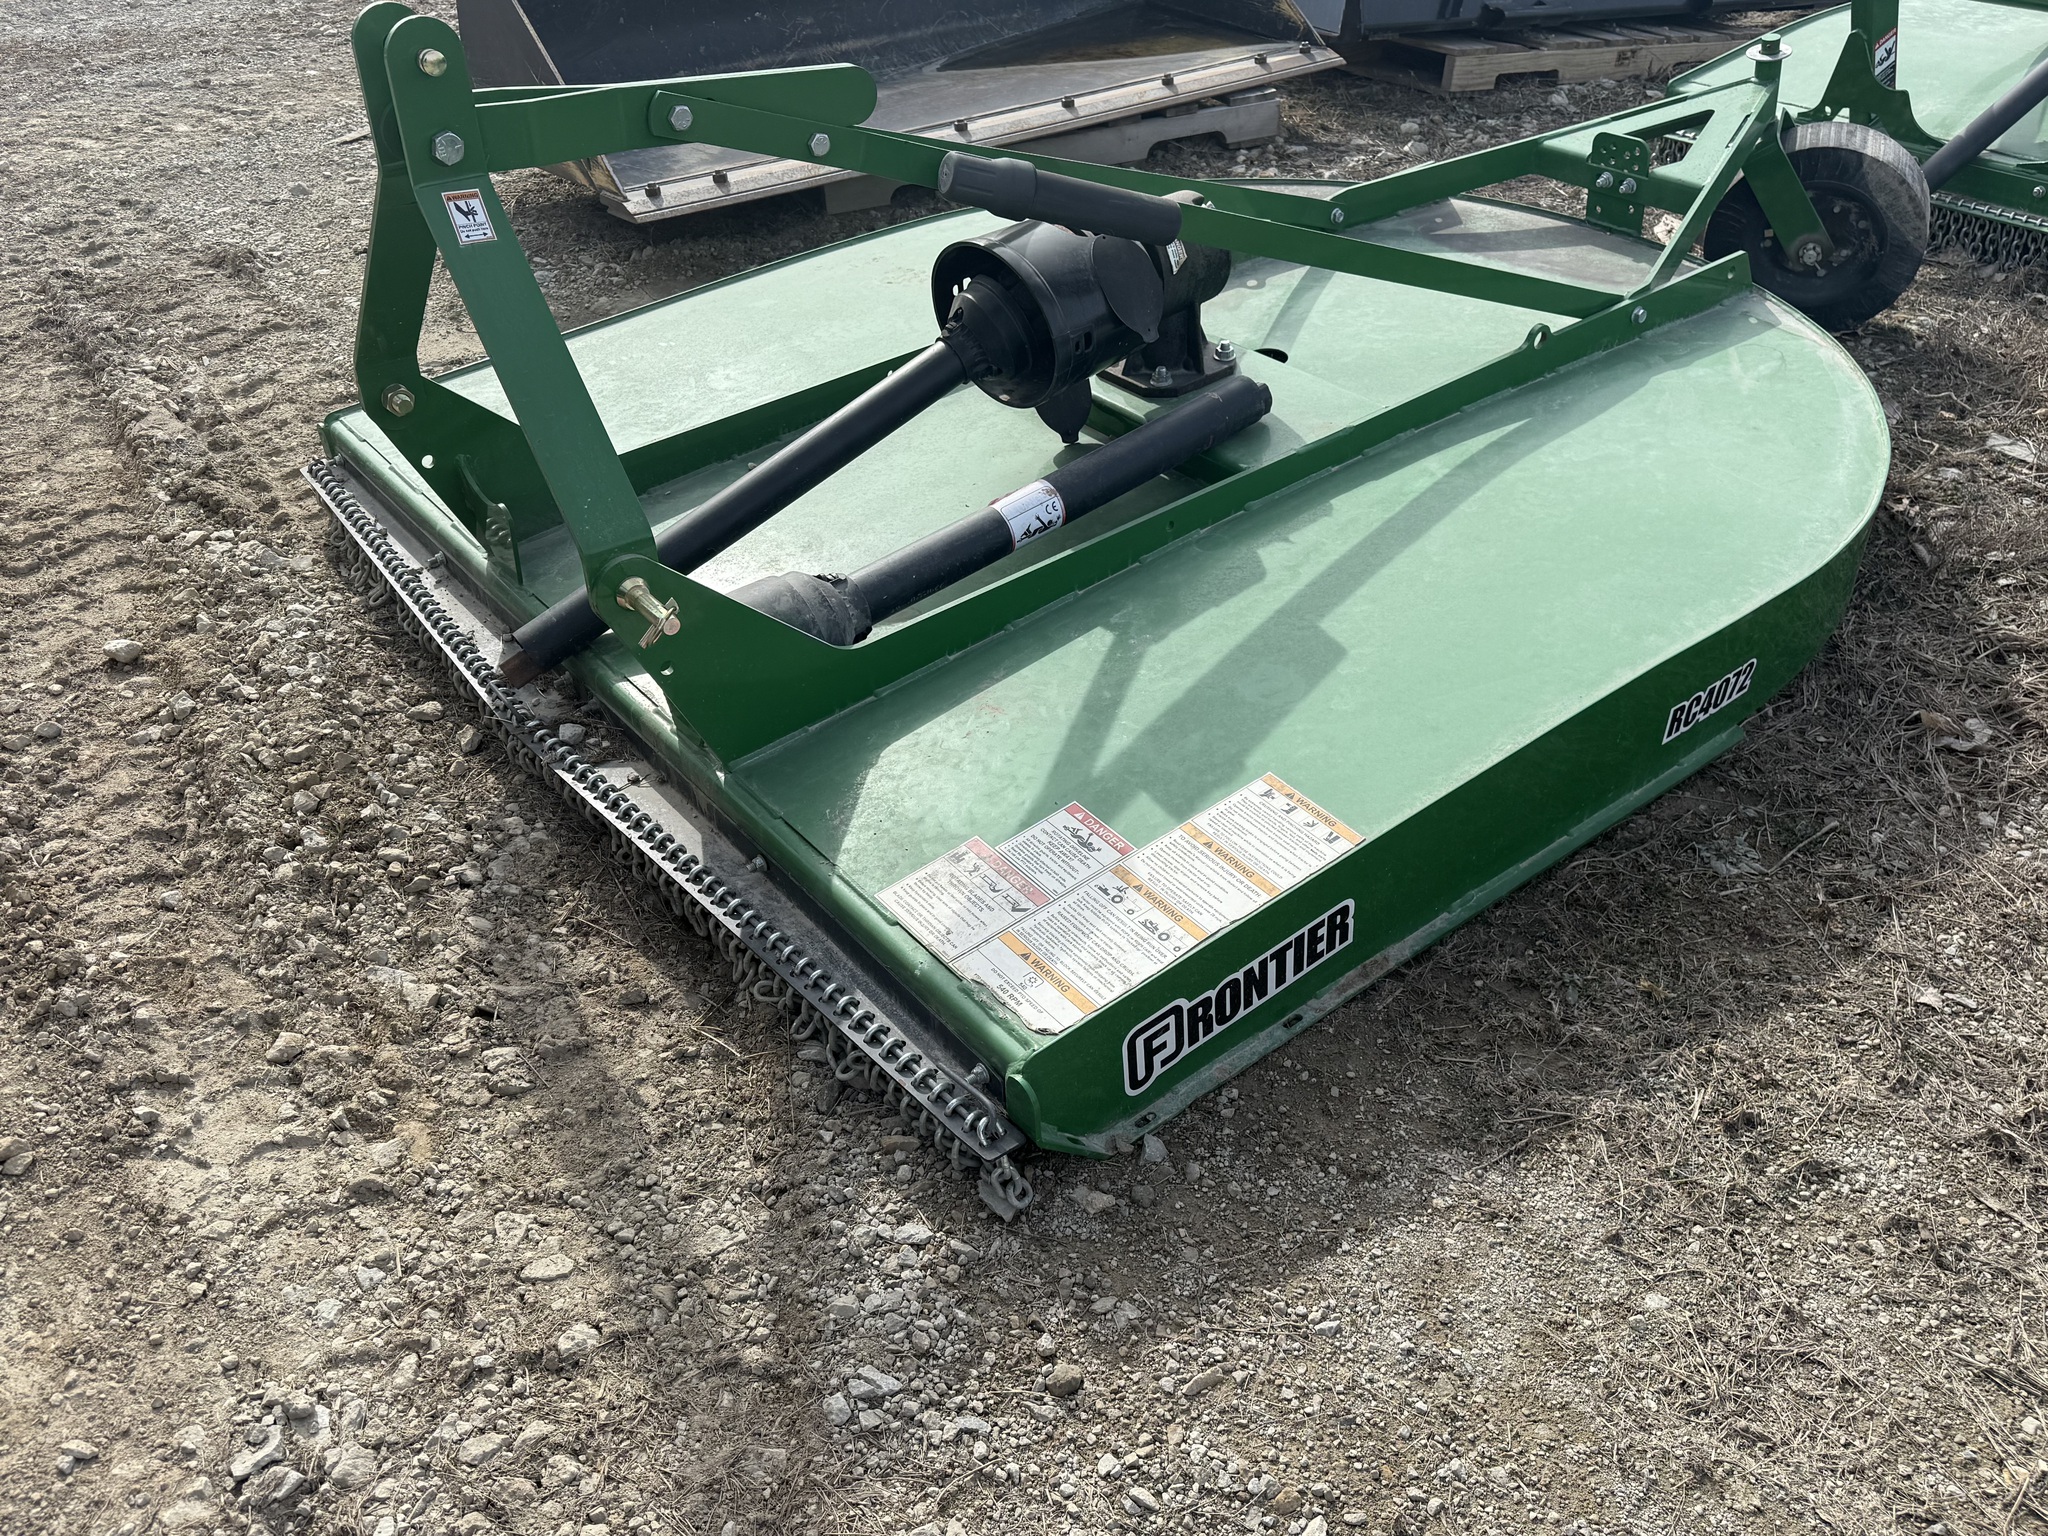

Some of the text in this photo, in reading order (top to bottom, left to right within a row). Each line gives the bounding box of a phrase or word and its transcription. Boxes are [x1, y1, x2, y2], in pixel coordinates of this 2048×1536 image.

[1880, 28, 1896, 46] DANGER
[1046, 501, 1058, 514] CE
[1666, 661, 1755, 739] RC4072
[1294, 797, 1338, 827] WARNING
[1039, 827, 1058, 842] CONTACT
[1063, 847, 1079, 858] CAUSE
[1076, 857, 1092, 869] DEATH
[1046, 840, 1060, 850] KEEP
[1082, 818, 1126, 850] DANGER
[1043, 845, 1062, 859] OPERATE
[1183, 839, 1200, 851] AVOID
[1196, 849, 1221, 866] SERIOUS
[1217, 865, 1237, 879] INJURY
[1234, 878, 1246, 886] OR
[1212, 847, 1256, 878] WARNING
[947, 872, 995, 912] ROTATING BLADES AND
[989, 859, 1035, 894] DANGER
[946, 879, 985, 912] THROWN OBJECTS
[1140, 889, 1185, 922] WARNING
[1082, 890, 1101, 904] FALLING
[1105, 908, 1117, 917] CAN
[1114, 915, 1131, 928] RESULT
[1133, 931, 1148, 942] BEING
[1145, 941, 1156, 949] RUN
[1028, 958, 1073, 992] WARNING
[995, 983, 1023, 1007] 540 RPM
[1002, 979, 1020, 992] EXCEED
[1016, 991, 1026, 999] PTO
[1023, 998, 1038, 1009] SPEED
[1126, 904, 1350, 1091] FRONTIER
